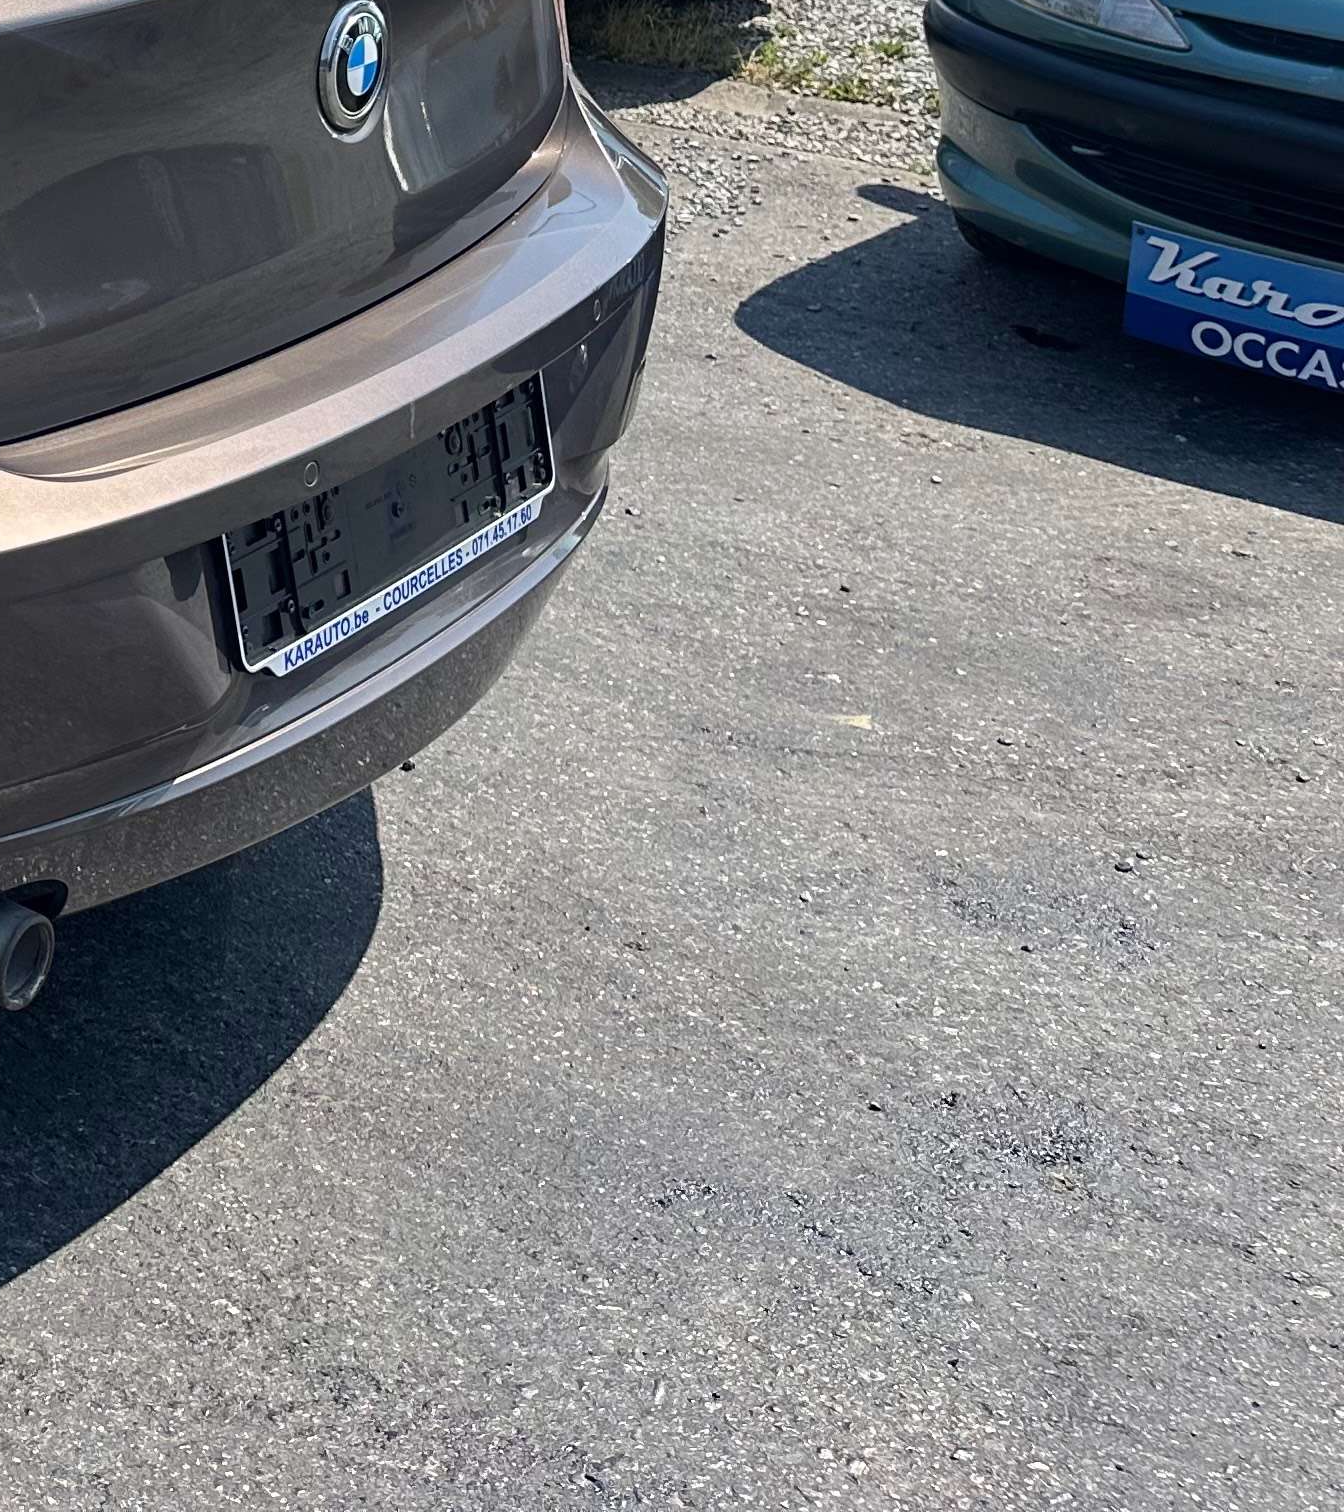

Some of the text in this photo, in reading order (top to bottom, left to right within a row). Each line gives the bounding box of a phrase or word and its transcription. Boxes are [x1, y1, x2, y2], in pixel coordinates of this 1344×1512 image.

[338, 17, 383, 51] BMW
[1191, 320, 1344, 388] OCCA
[283, 611, 369, 670] KARAUTO.be
[383, 548, 463, 611] COURCELLES
[472, 504, 532, 556] 071.45.17.60
